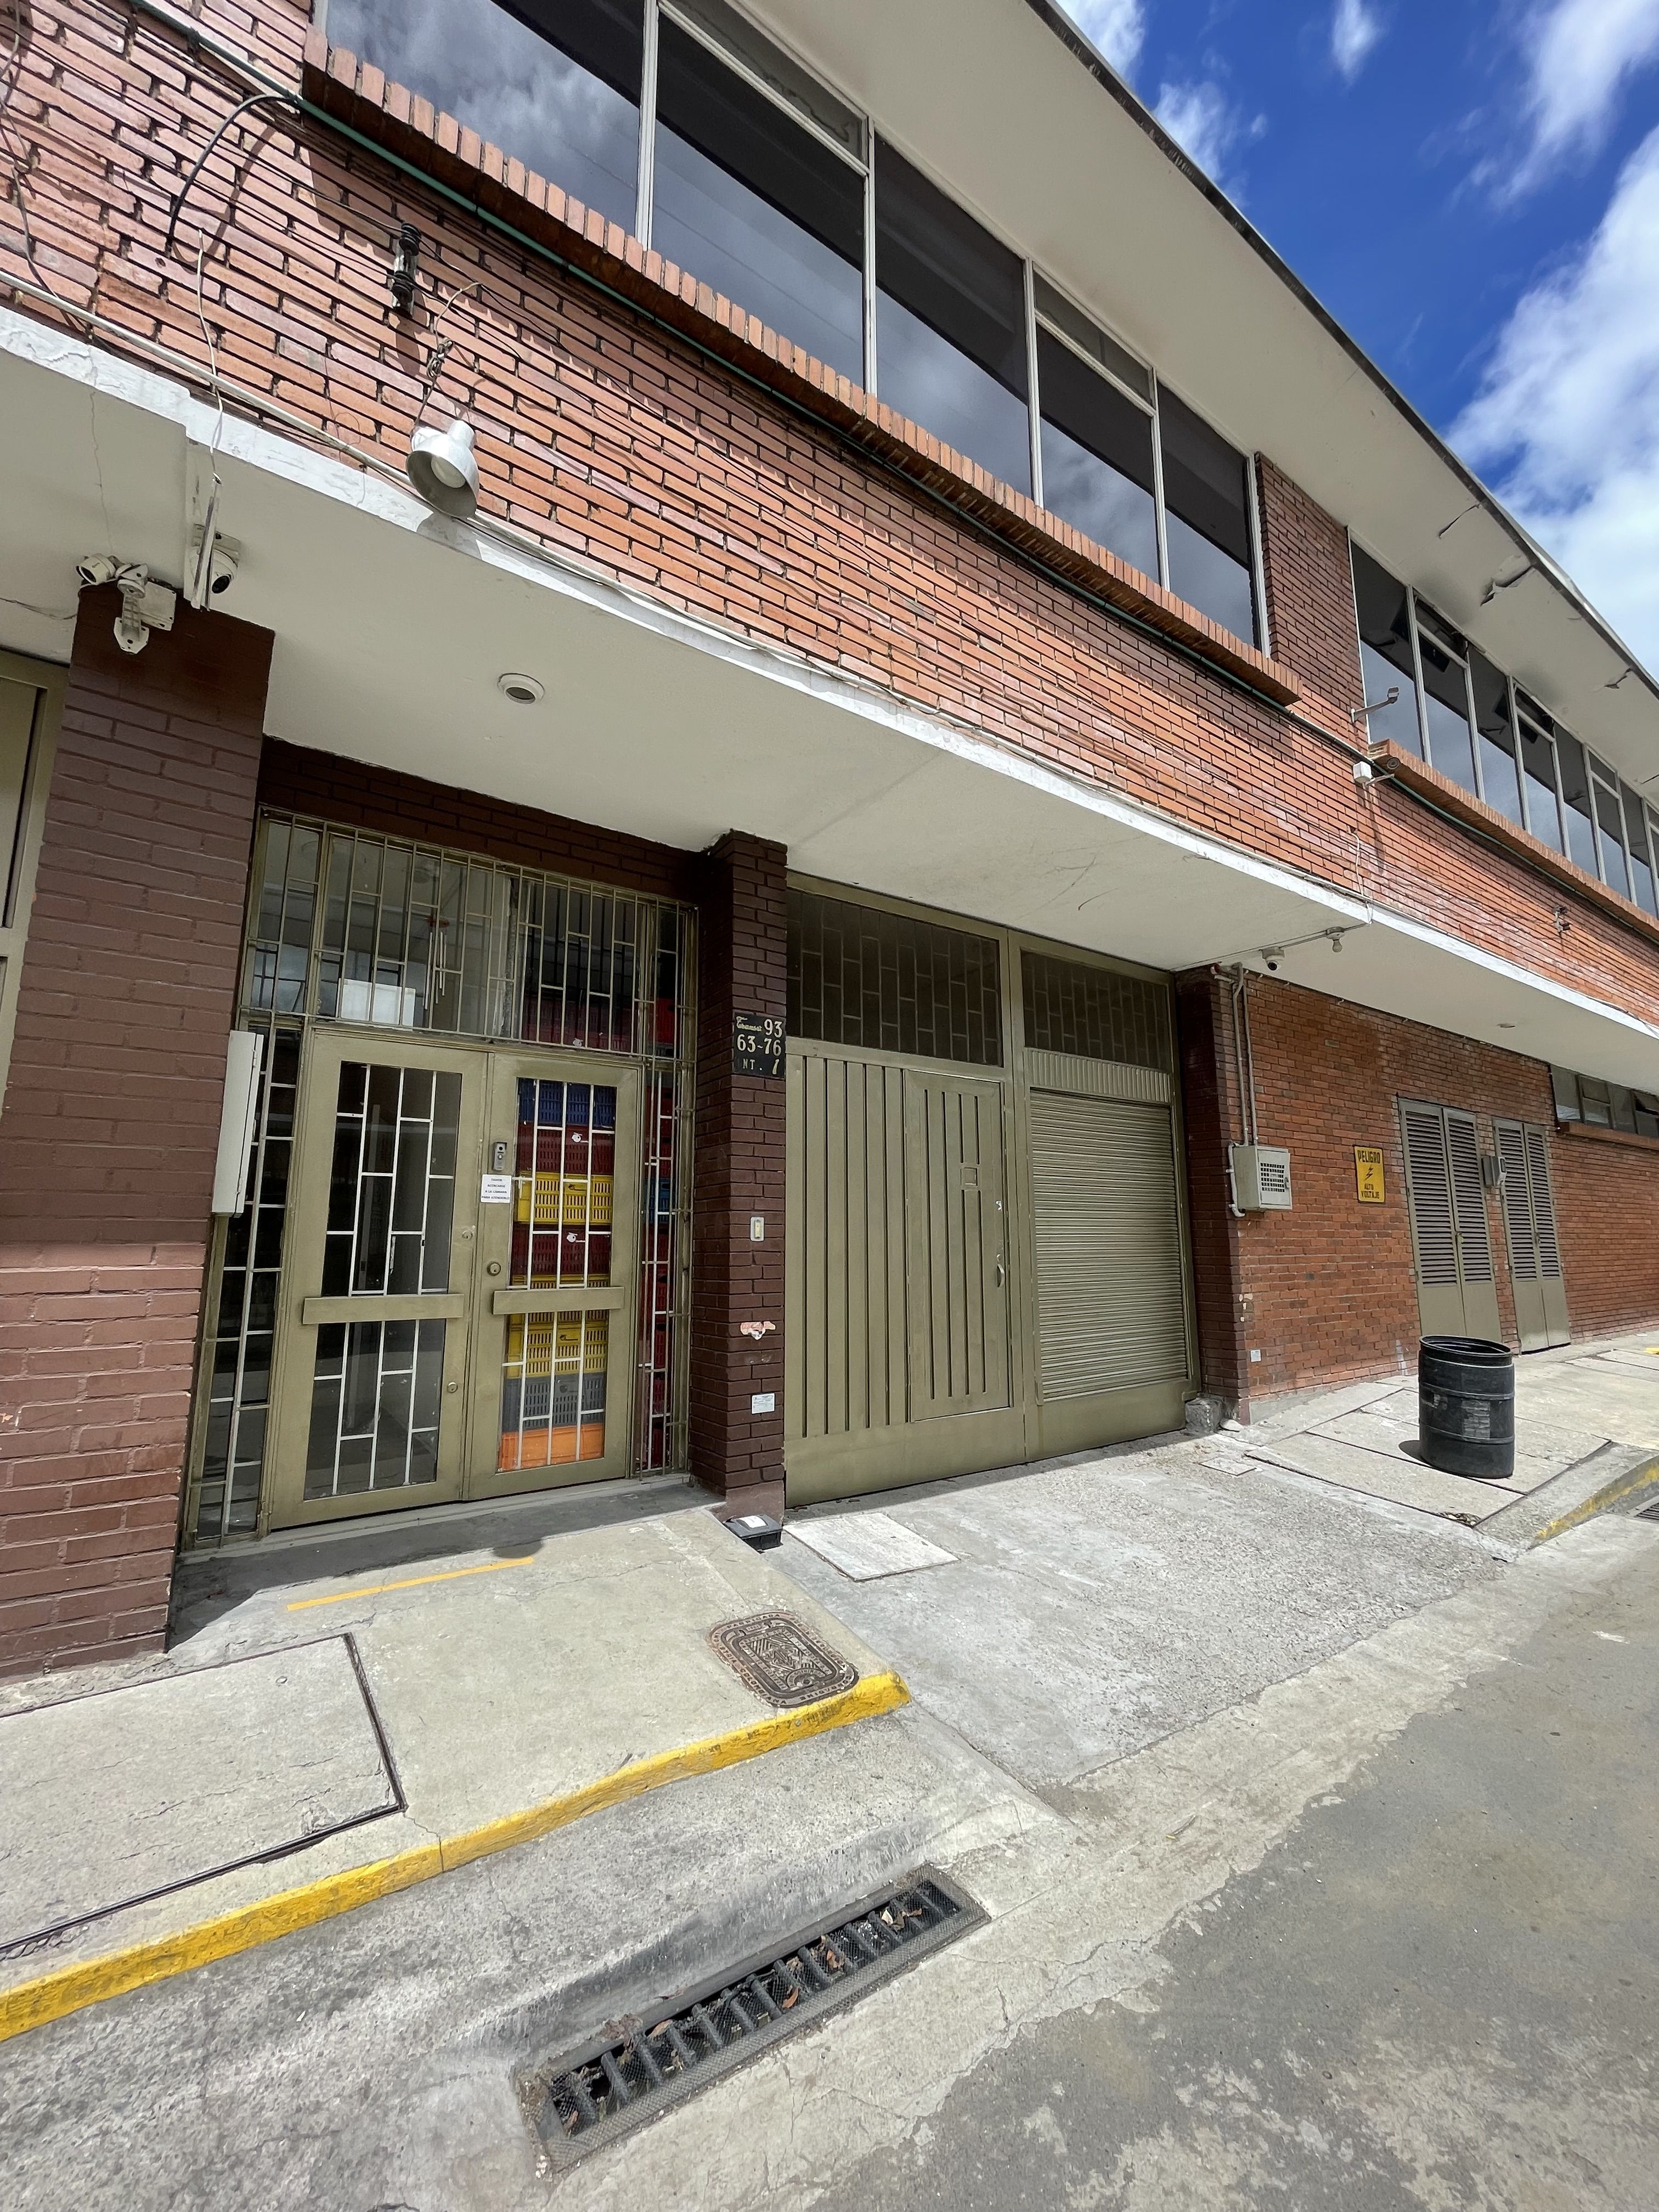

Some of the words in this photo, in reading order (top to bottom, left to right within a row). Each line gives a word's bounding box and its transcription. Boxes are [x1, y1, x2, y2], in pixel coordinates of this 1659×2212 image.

[764, 1019, 783, 1038] 93
[772, 1059, 780, 1074] 1
[1357, 1150, 1381, 1164] PELIGRO
[1361, 1190, 1380, 1199] VOLTAJE
[713, 1632, 737, 1663] INDSTRIA
[740, 1667, 787, 1705] COLOMBIANA
